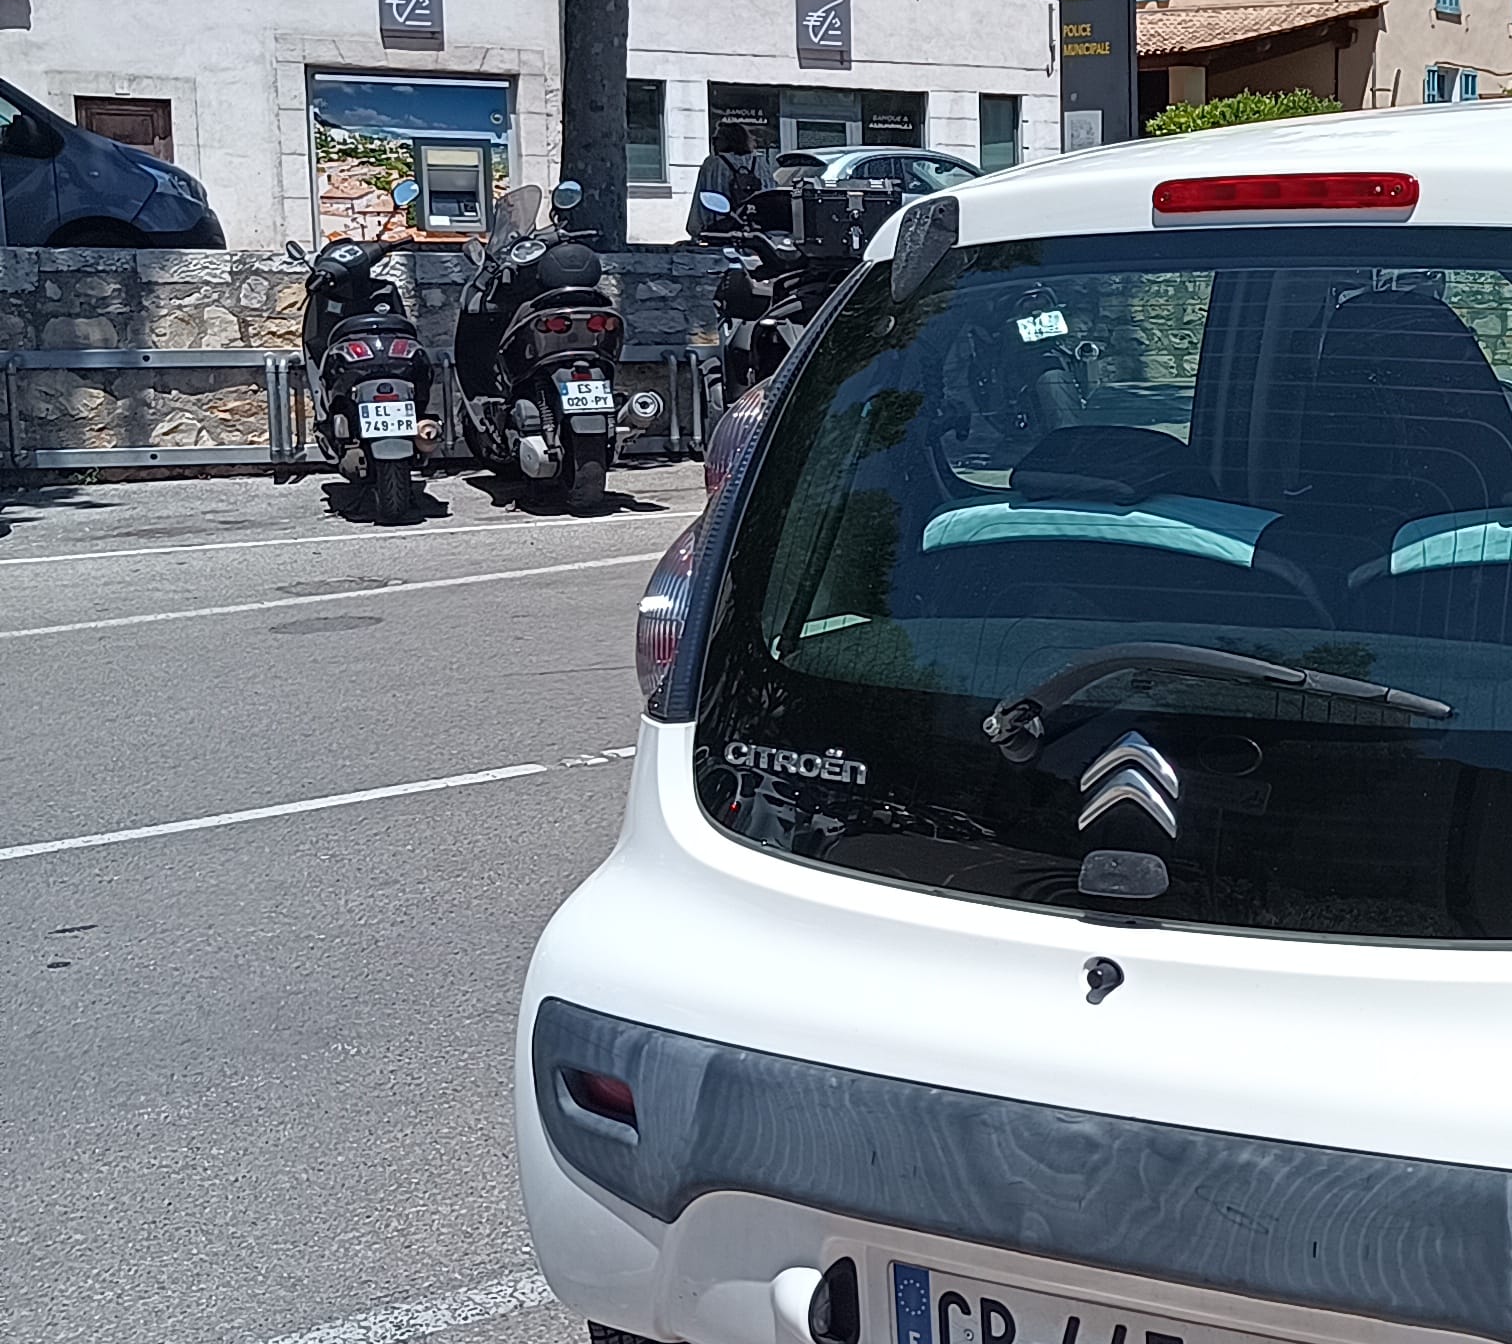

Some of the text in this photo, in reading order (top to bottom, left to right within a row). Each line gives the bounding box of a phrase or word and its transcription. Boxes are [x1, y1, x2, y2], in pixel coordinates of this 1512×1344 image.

[1063, 23, 1092, 37] POLICE
[1063, 41, 1110, 56] MUNICIPALE
[724, 741, 867, 785] CITROËN
